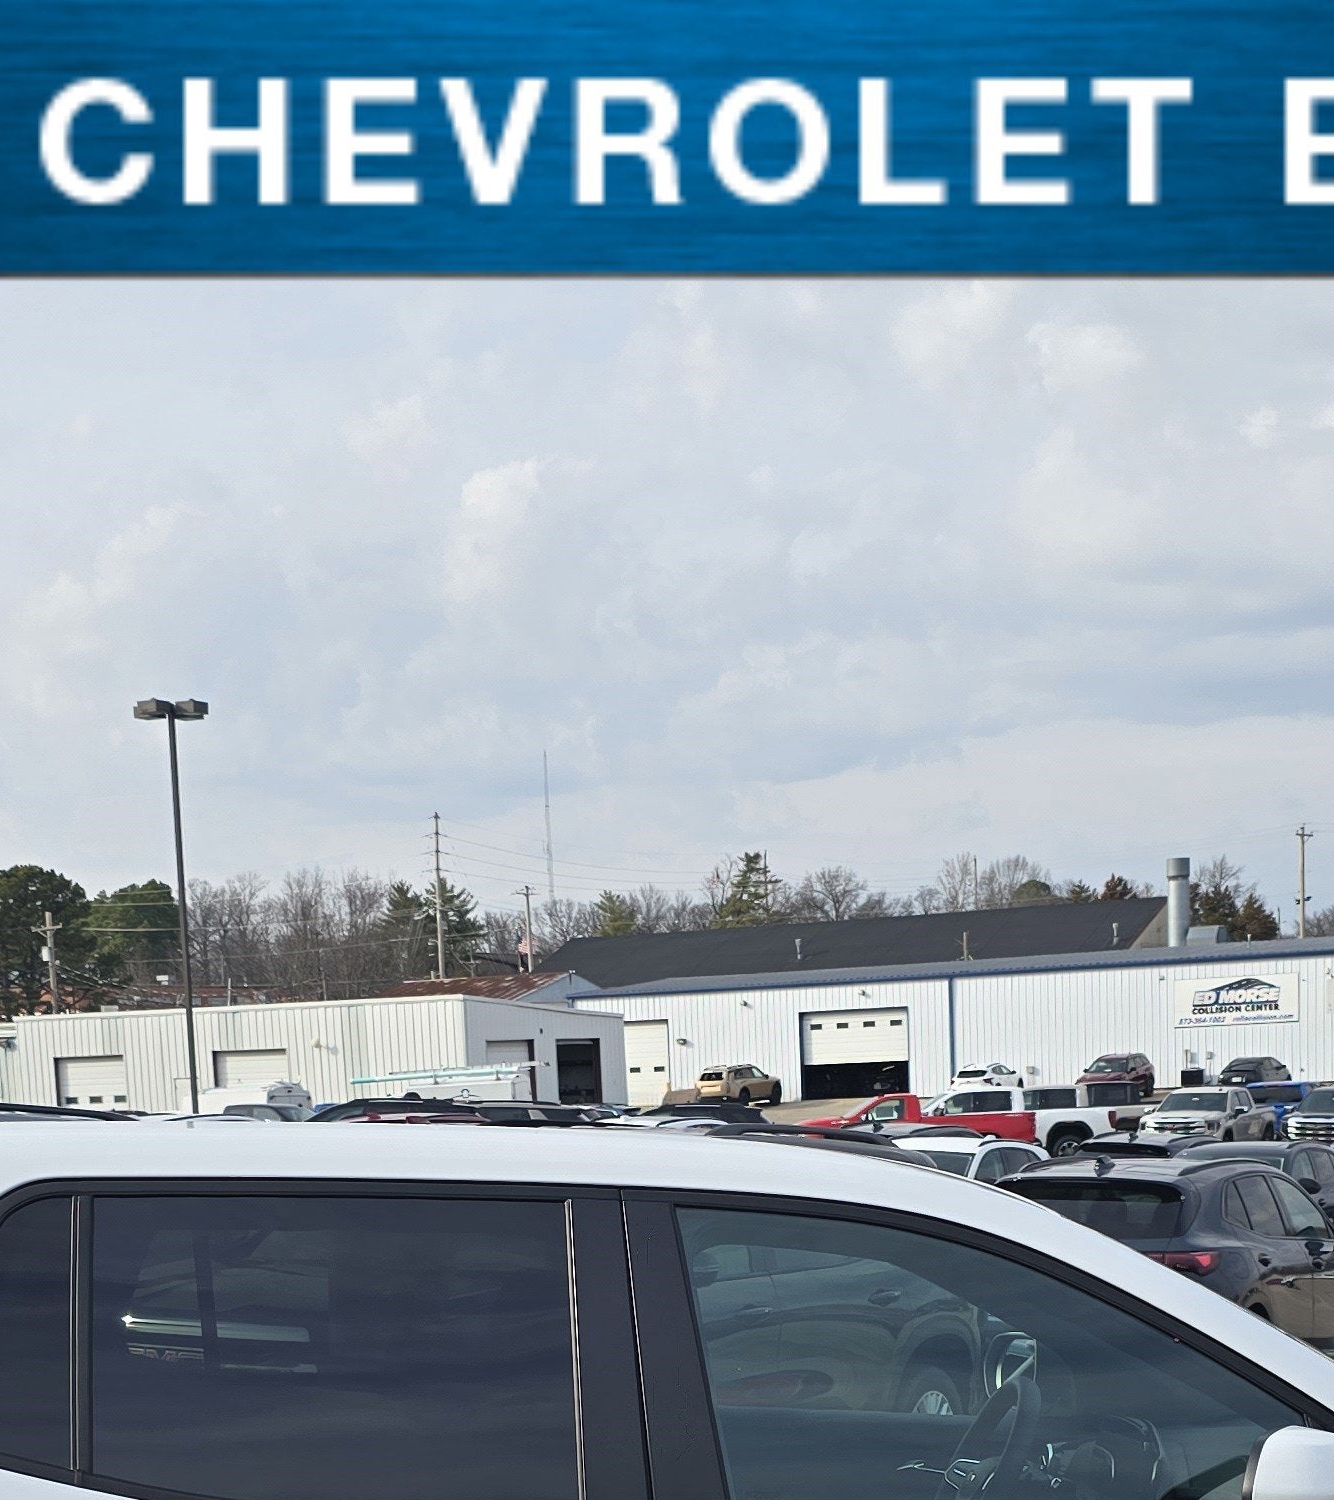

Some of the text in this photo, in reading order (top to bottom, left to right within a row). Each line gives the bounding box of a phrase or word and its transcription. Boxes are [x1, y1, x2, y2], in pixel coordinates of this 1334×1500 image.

[1192, 986, 1280, 1005] ED MORSE
[1192, 1003, 1280, 1015] COLLISION CENTER
